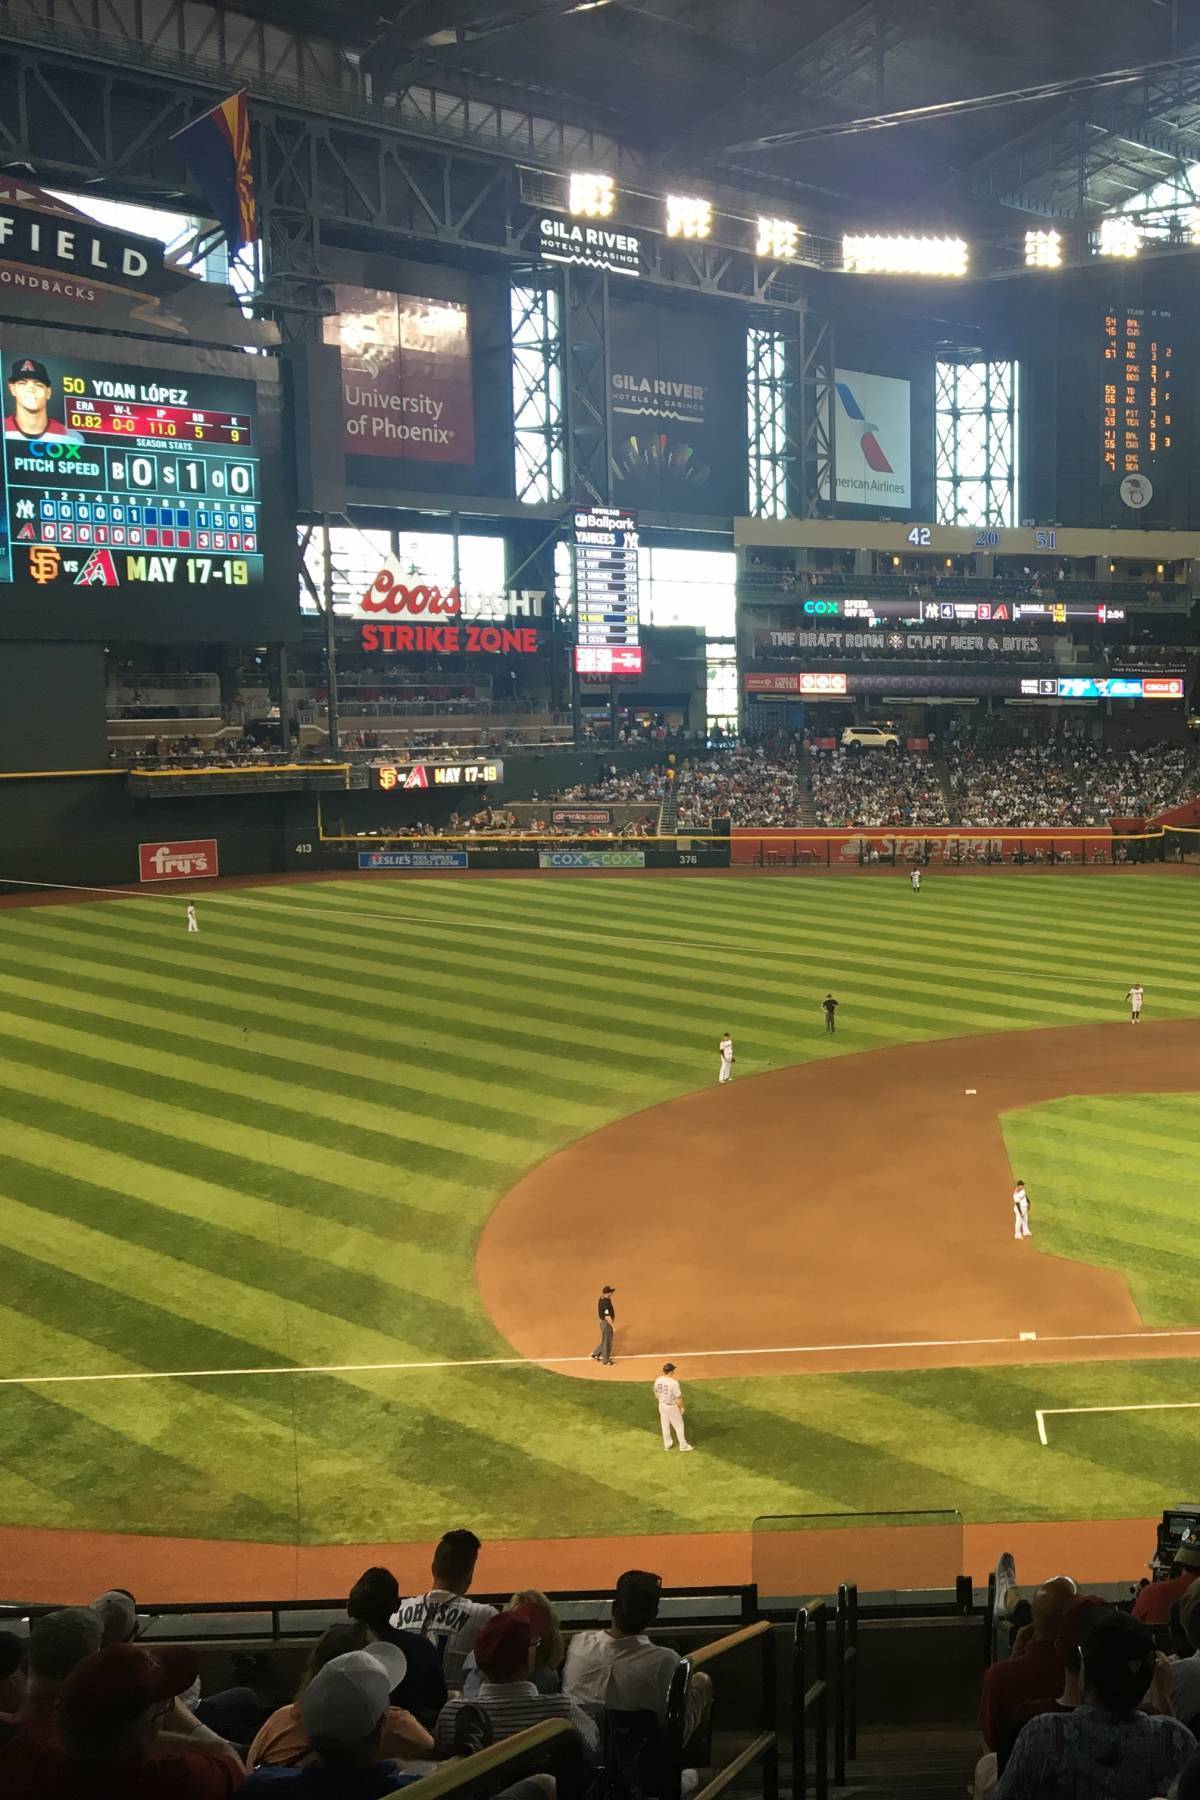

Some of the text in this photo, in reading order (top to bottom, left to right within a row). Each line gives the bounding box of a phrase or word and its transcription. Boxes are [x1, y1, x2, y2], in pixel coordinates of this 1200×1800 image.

[541, 219, 638, 253] GILA RIVER
[0, 216, 148, 277] FIELD
[541, 239, 580, 252] HOTELS
[596, 251, 639, 264] CASINOS
[1105, 317, 1116, 326] 54
[1105, 349, 1116, 358] 57
[1151, 365, 1157, 373] 3
[63, 377, 188, 405] 50 YOAN LÓPEZ
[612, 373, 704, 401] GILA RIVER
[1105, 385, 1156, 396] 55 2
[345, 385, 443, 421] University
[612, 393, 649, 404] HOTELS
[1150, 397, 1156, 406] 3
[76, 401, 238, 426] ERA W-L IP BB K
[1105, 408, 1116, 417] 73
[71, 414, 239, 442] 0.82 0-0 11.0 5 9
[347, 415, 449, 444] of Phoenix
[1105, 431, 1115, 439] 41
[28, 442, 81, 460] COX
[136, 438, 193, 451] SEASON STATS
[1105, 438, 1171, 450] 55 3 3
[1105, 453, 1115, 461] 34
[14, 458, 100, 476] PITCH SPEED
[112, 462, 124, 480] B
[132, 458, 152, 486] 0
[163, 466, 175, 484] S
[186, 463, 197, 489] 1
[231, 467, 249, 493] 0
[871, 480, 904, 494] Airlines
[44, 491, 49, 499] 1
[61, 492, 69, 500] 2
[78, 493, 85, 501] 3
[113, 496, 119, 504] 5
[129, 497, 136, 505] 6
[146, 498, 152, 506] 7
[44, 505, 253, 528] 0 0 0 0 0 1 1 5 0 5
[588, 515, 635, 530] Ballpark
[44, 526, 254, 549] 0 2 0 1 0 0 3 5 1 4
[575, 531, 615, 545] YANKEES
[908, 527, 931, 546] 42
[976, 530, 999, 547] 20
[1035, 531, 1056, 549] 51
[126, 556, 177, 582] MAY
[186, 558, 248, 585] 17-19
[361, 569, 461, 614] Coors
[804, 600, 838, 614] COX
[361, 624, 538, 653] STRIKE ZONE
[770, 631, 796, 646] THE
[799, 632, 843, 648] DRAFT
[846, 634, 884, 648] ROOM
[906, 635, 947, 649] CRAFT
[950, 636, 983, 650] BEER
[434, 768, 460, 784] MAY
[464, 766, 497, 782] 17-19
[295, 844, 313, 854] 413
[150, 847, 208, 875] fry's
[372, 854, 410, 864] LESLIE'S
[552, 854, 633, 865] COX COX
[679, 855, 697, 864] 376
[396, 1603, 471, 1633] JOHNSON
